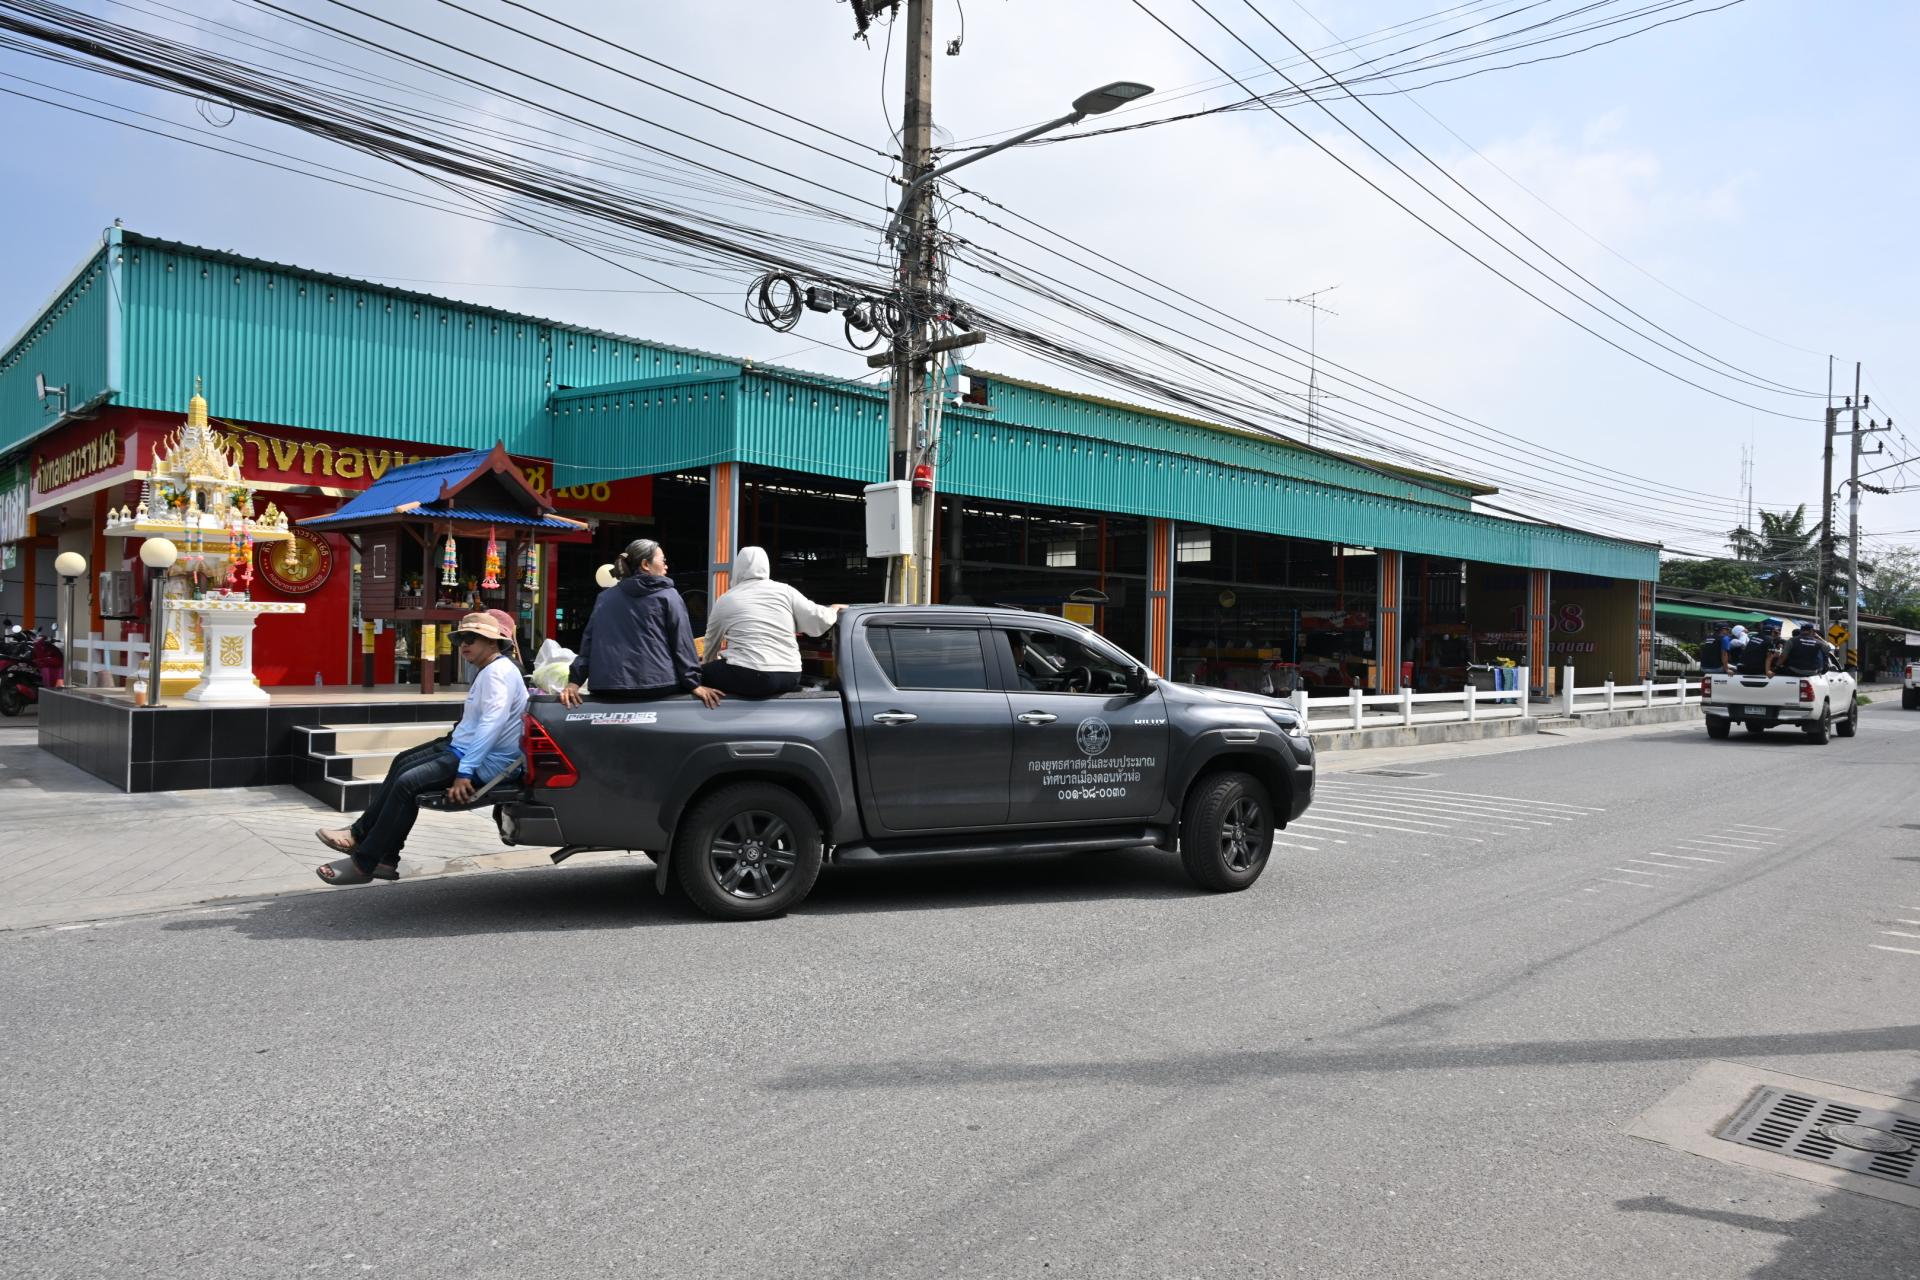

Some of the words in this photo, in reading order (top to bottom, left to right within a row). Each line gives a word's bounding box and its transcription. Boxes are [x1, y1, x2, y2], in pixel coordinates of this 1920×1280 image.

[98, 429, 116, 468] 168
[1028, 755, 1156, 775] กองยุทธศาสตร์และงบประมาณ
